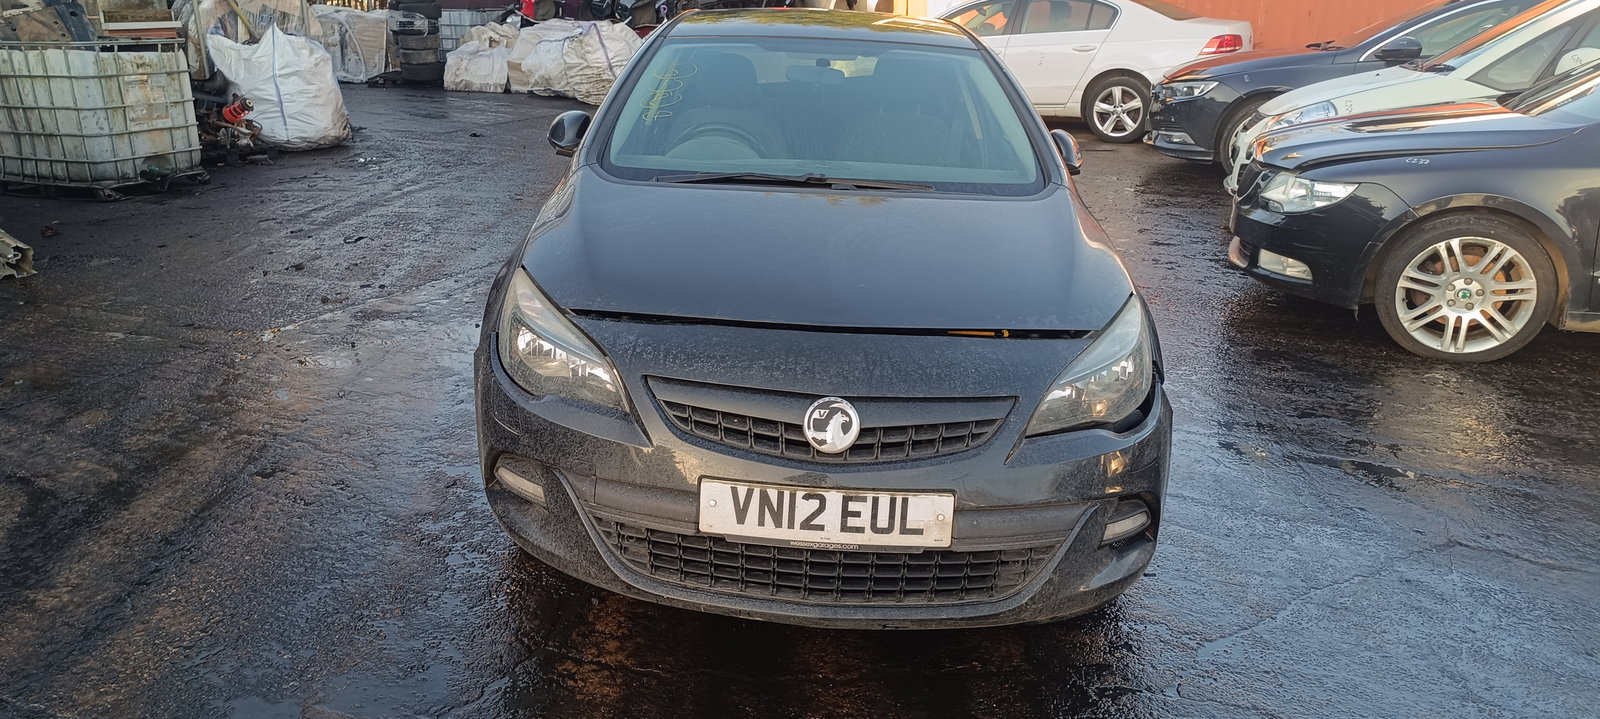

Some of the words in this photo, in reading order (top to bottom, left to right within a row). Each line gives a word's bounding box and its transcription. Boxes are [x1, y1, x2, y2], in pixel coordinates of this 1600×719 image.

[730, 486, 827, 531] VN12
[840, 495, 924, 535] EUL
[789, 540, 859, 550] wessexgarages.com
